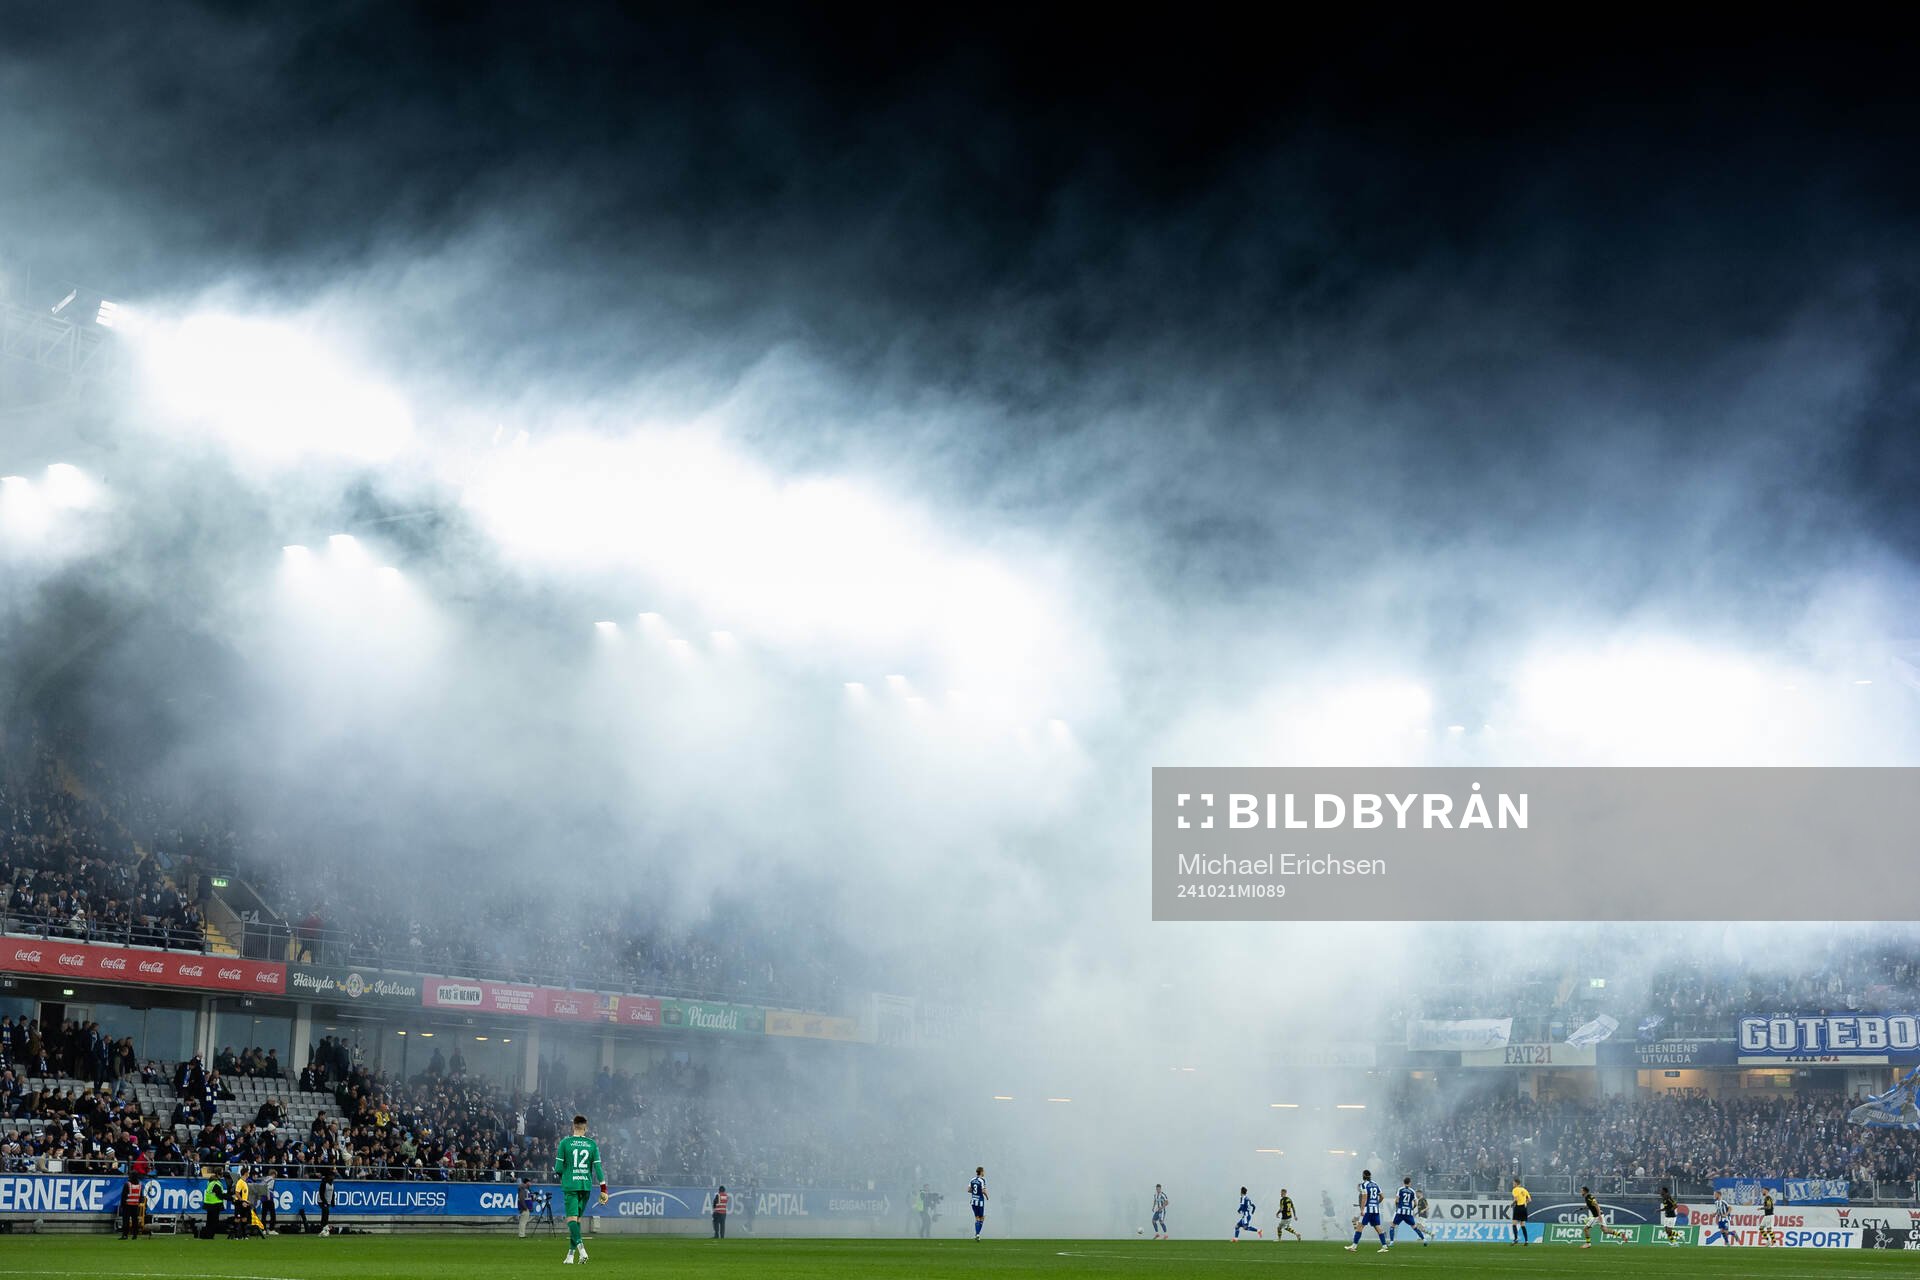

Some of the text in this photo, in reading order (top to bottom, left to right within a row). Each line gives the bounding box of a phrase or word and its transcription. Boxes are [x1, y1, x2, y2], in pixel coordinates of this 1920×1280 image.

[293, 972, 416, 996] Härryda Karlsson
[688, 1006, 737, 1030] Picadeli
[1504, 1045, 1553, 1064] FAT21
[572, 1149, 590, 1168] 12
[972, 1184, 978, 1195] 3
[1370, 1187, 1378, 1199] 13
[302, 1190, 446, 1207] NDICWELLNESS
[754, 1192, 809, 1215] APITAL
[1402, 1192, 1411, 1203] 21
[619, 1198, 664, 1216] cuebid
[1450, 1203, 1511, 1219] OPTIK
[1558, 1209, 1614, 1224] cued
[1840, 1219, 1890, 1229] RASTA
[1911, 1220, 1920, 1229] R
[1556, 1228, 1582, 1238] MCR
[1909, 1229, 1920, 1240] G
